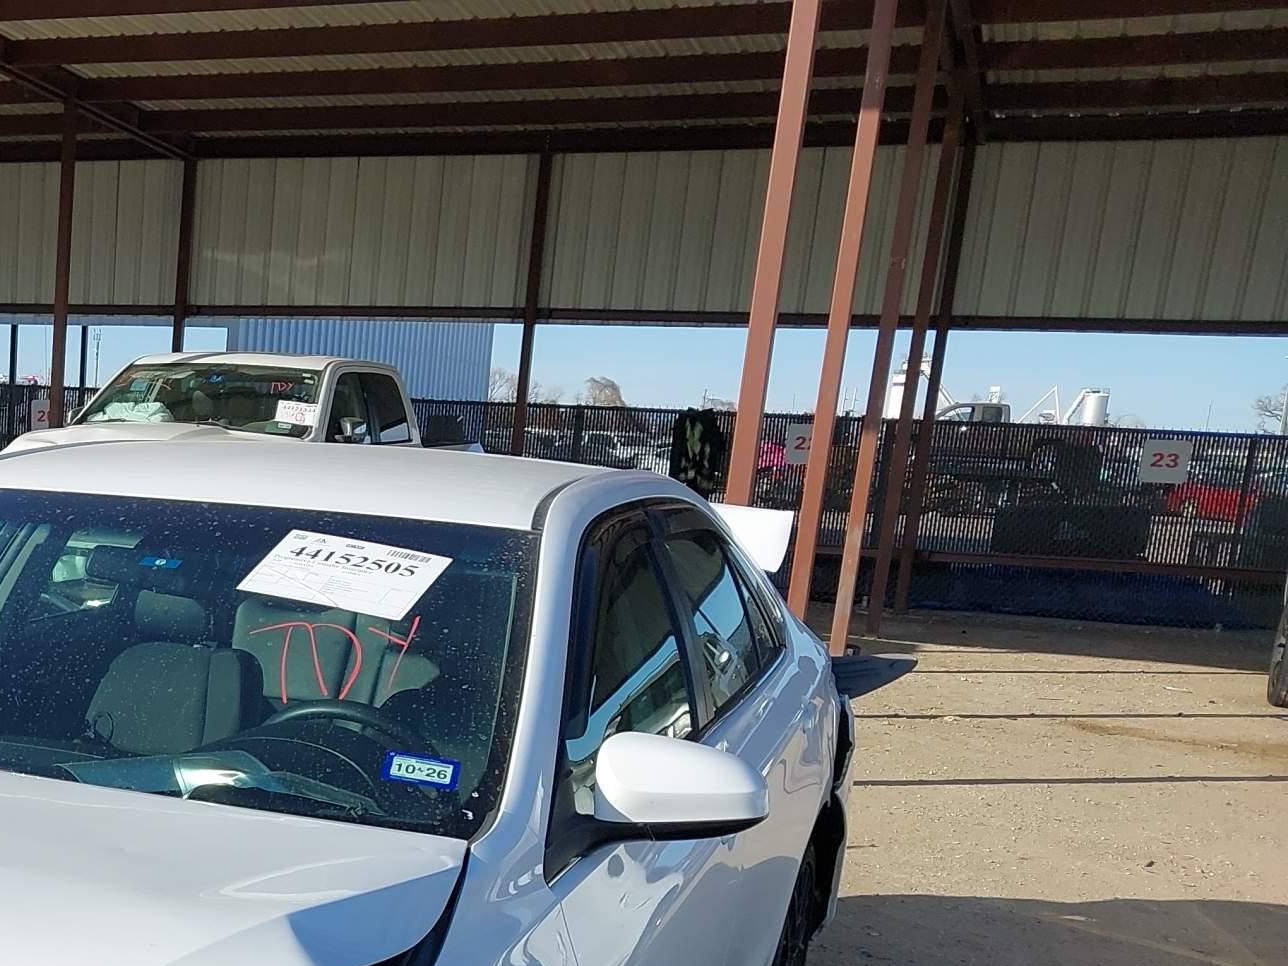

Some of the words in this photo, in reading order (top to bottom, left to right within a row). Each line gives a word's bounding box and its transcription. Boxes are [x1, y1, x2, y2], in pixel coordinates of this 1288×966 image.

[793, 435, 813, 450] 2
[1149, 452, 1180, 468] 23
[289, 546, 421, 577] 44152505
